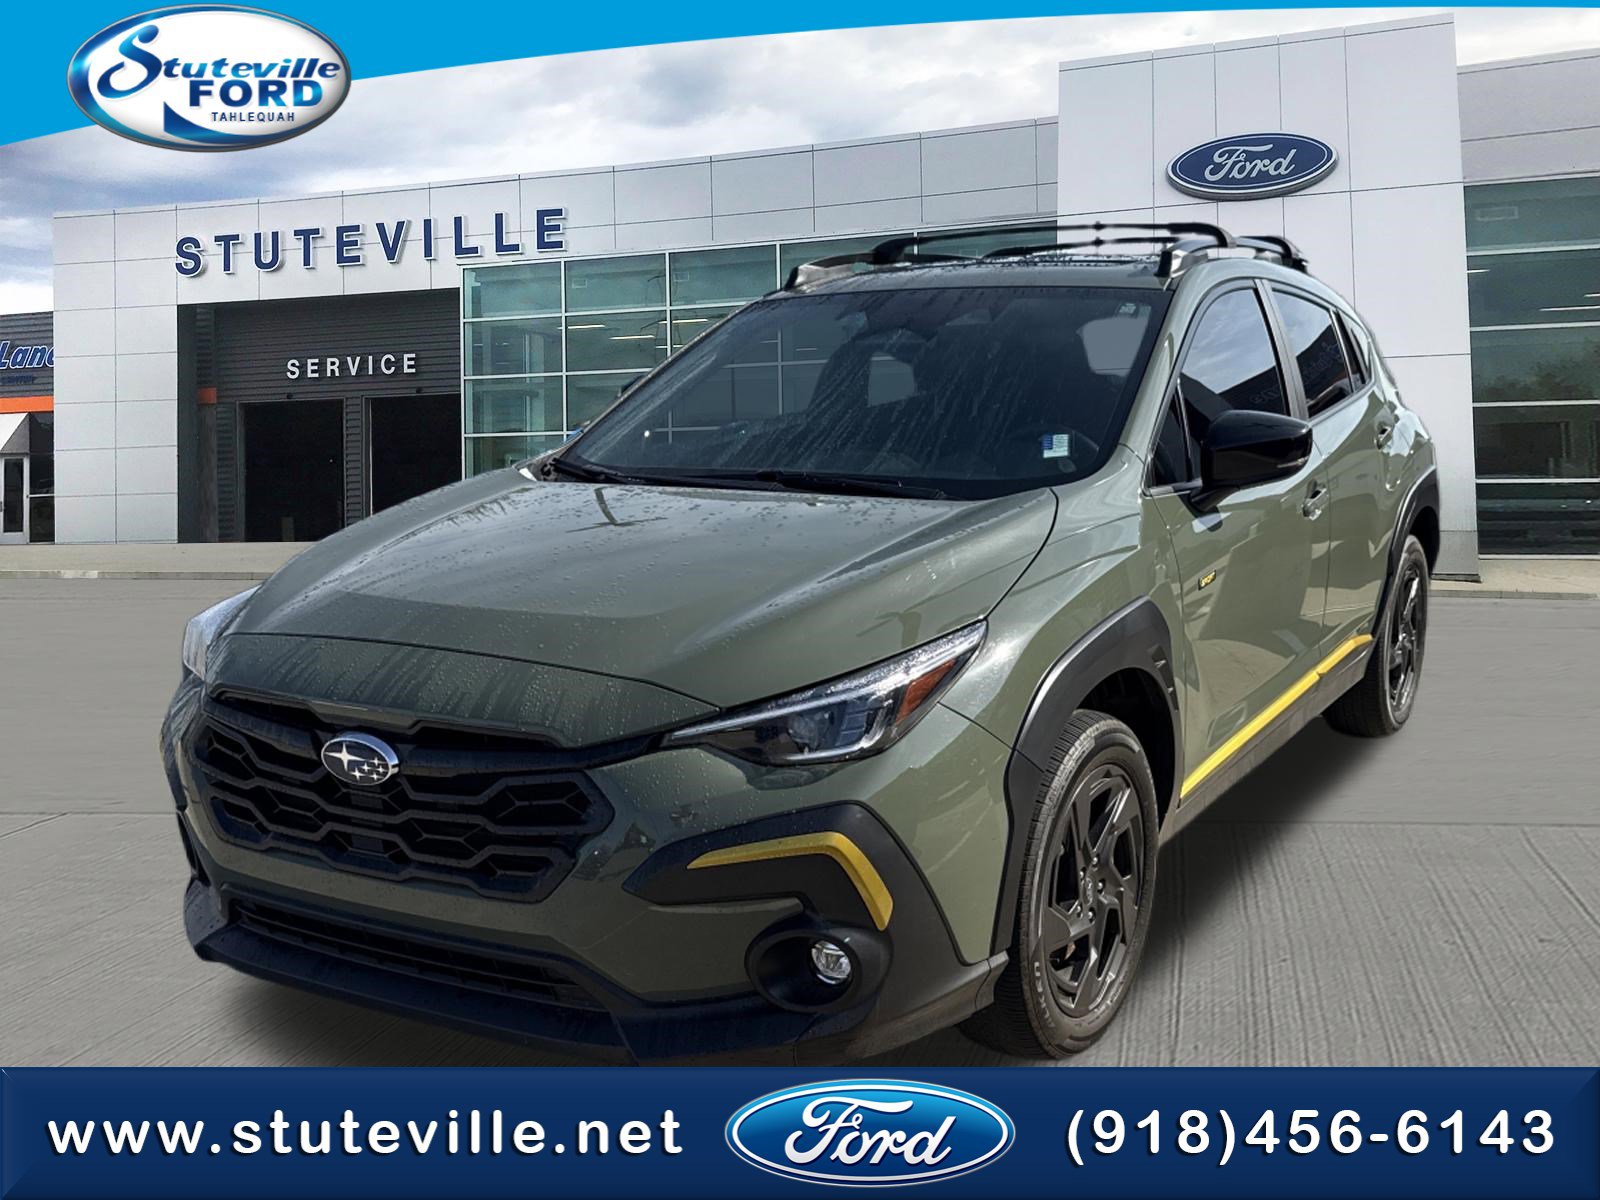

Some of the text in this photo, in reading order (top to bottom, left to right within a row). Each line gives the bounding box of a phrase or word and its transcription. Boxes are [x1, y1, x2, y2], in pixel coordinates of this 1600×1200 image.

[1204, 143, 1297, 182] Ford
[174, 207, 568, 278] STUTEVILLE
[285, 353, 418, 380] SERVICE
